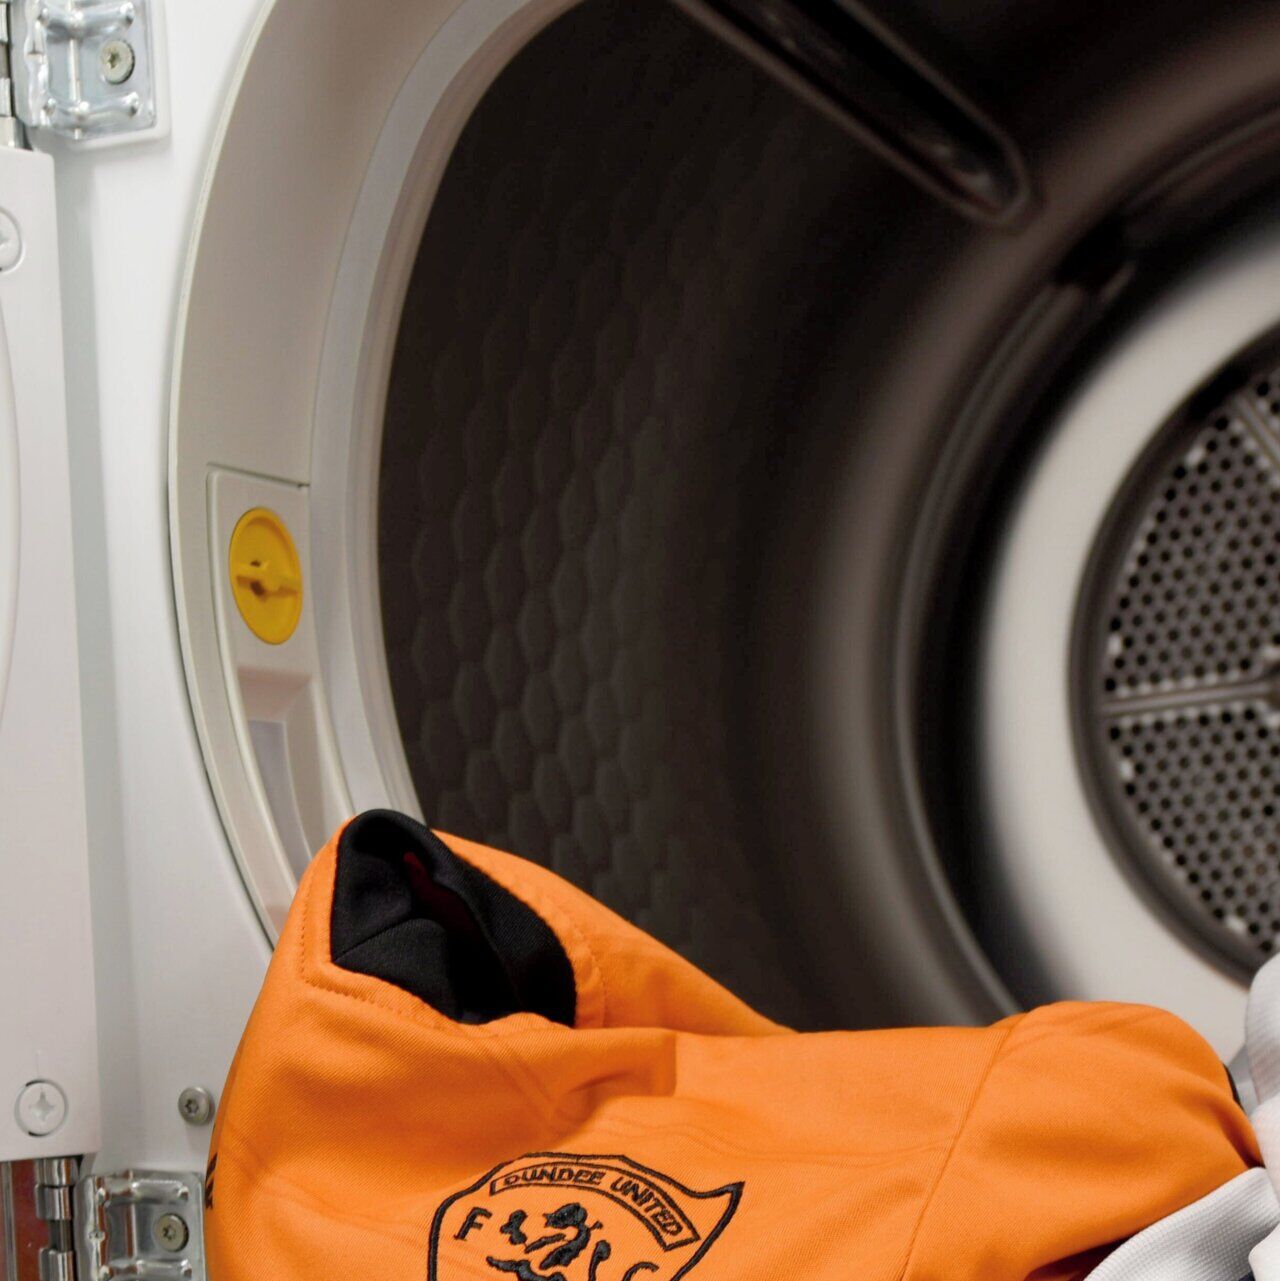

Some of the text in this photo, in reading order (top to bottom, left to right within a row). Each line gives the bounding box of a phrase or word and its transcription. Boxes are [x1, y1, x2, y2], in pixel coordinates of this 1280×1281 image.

[453, 1205, 493, 1241] F
[503, 1166, 684, 1236] DUNDEE UNITED
